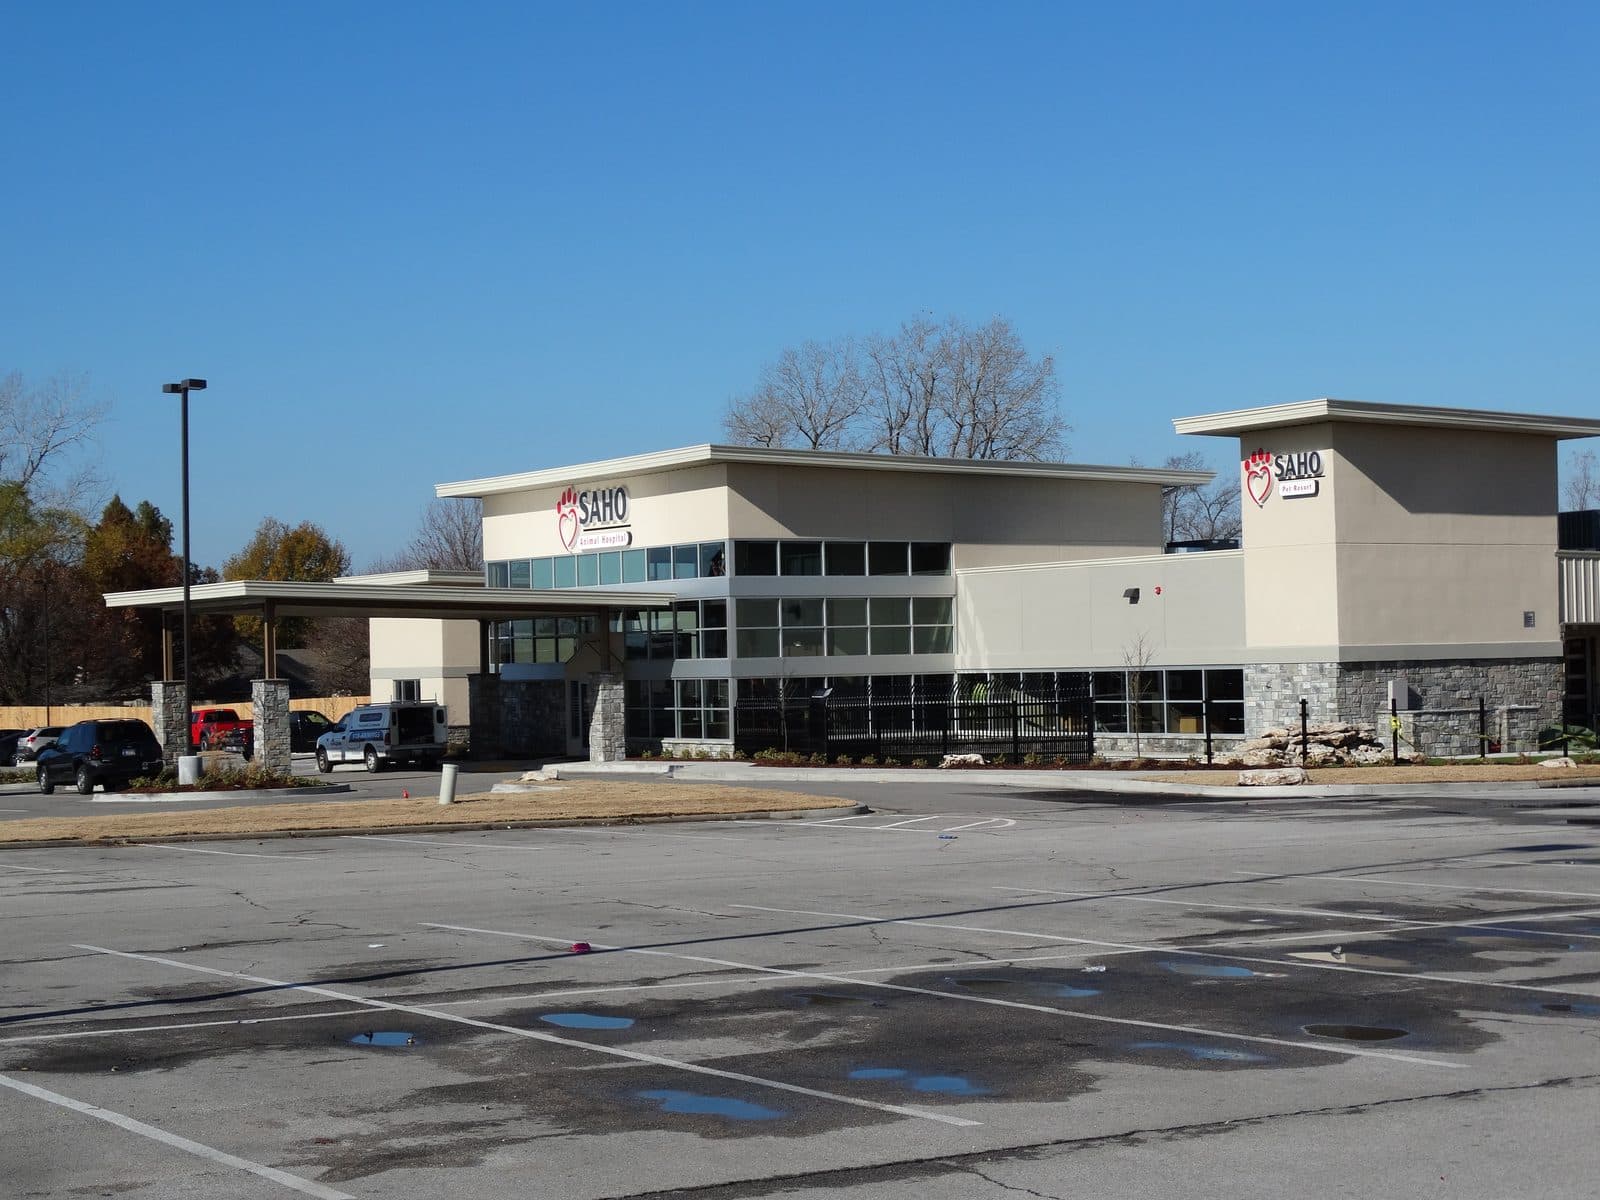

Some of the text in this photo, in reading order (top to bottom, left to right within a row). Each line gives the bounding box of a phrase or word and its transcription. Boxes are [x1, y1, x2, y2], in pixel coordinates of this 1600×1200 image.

[1275, 451, 1321, 477] SAHO
[579, 487, 627, 524] SAHO
[580, 533, 627, 545] Animal Hospital
